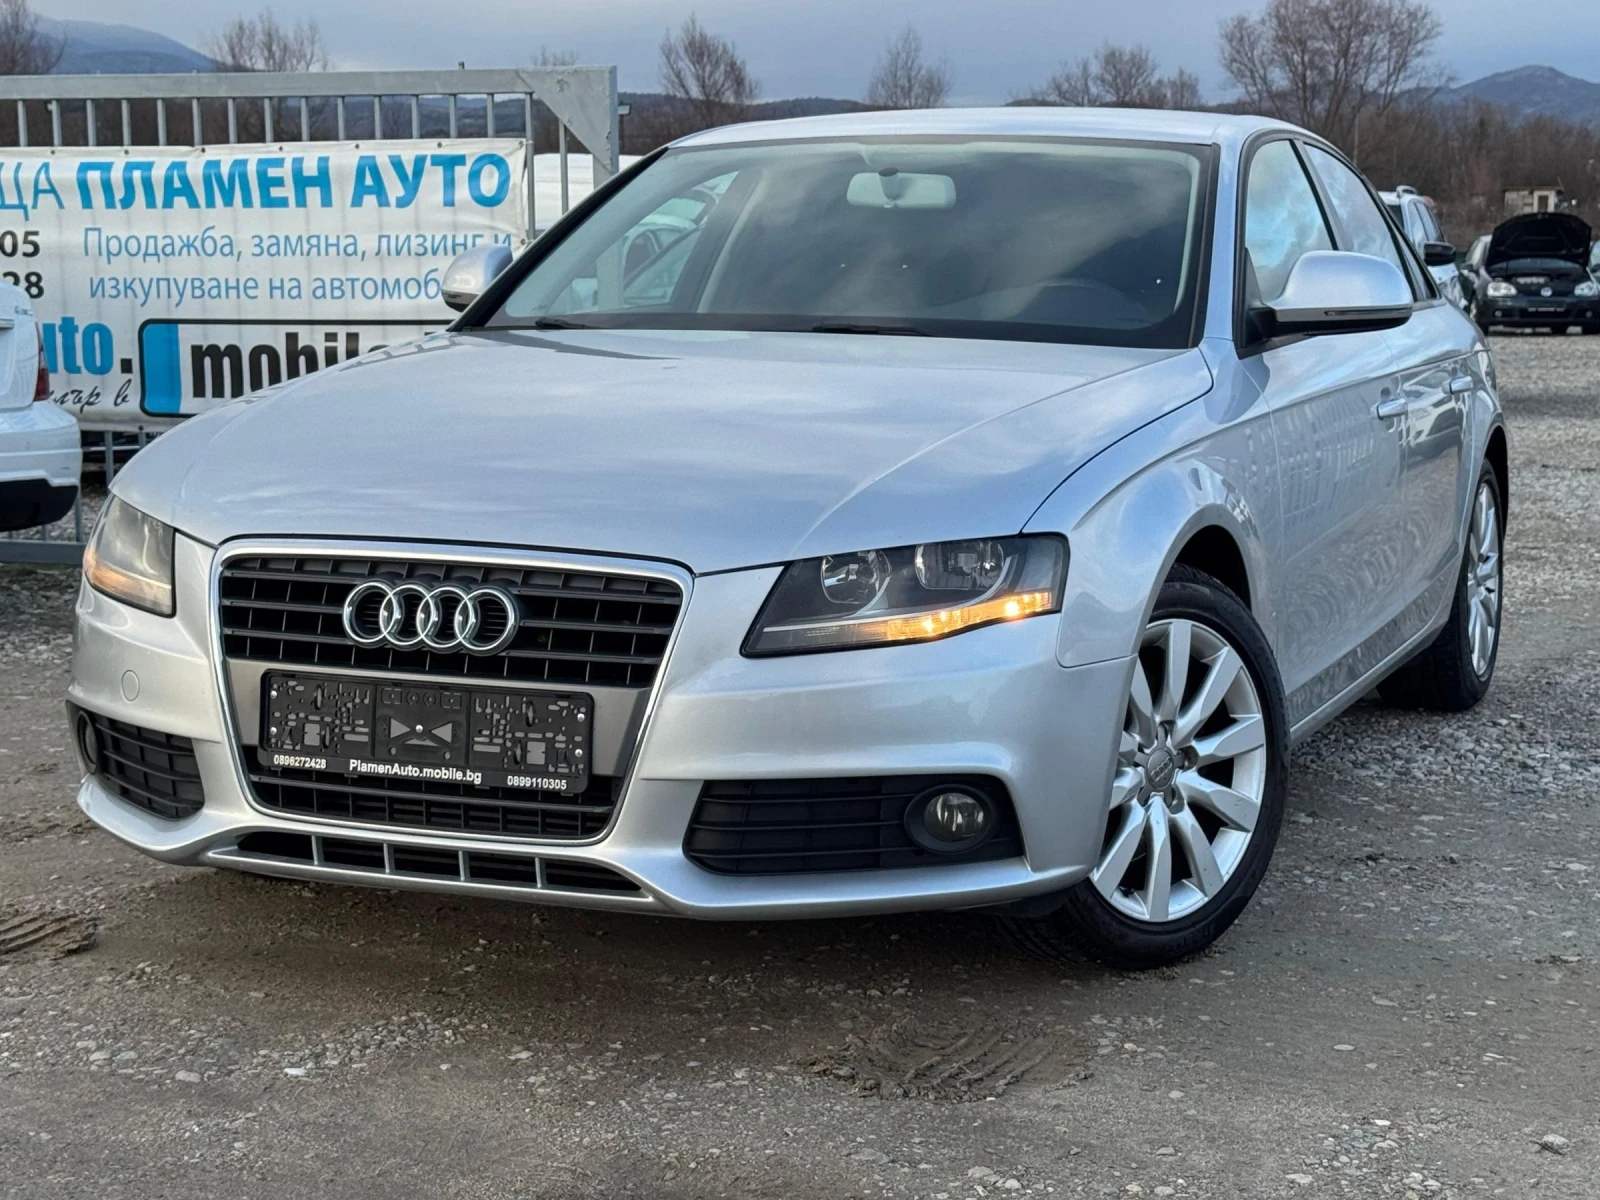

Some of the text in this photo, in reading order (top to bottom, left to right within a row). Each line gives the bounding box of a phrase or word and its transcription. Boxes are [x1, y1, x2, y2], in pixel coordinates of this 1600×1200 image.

[76, 156, 336, 210] ПЛАМЕН
[350, 153, 512, 208] АУТО
[83, 227, 242, 264] Продажба,
[251, 235, 367, 263] замяна,
[375, 233, 484, 257] лизинг
[89, 274, 259, 308] изкупуване
[269, 275, 303, 300] на
[273, 754, 567, 790] 0896272428 PlamenAuto.mobile.bg 0899110305
